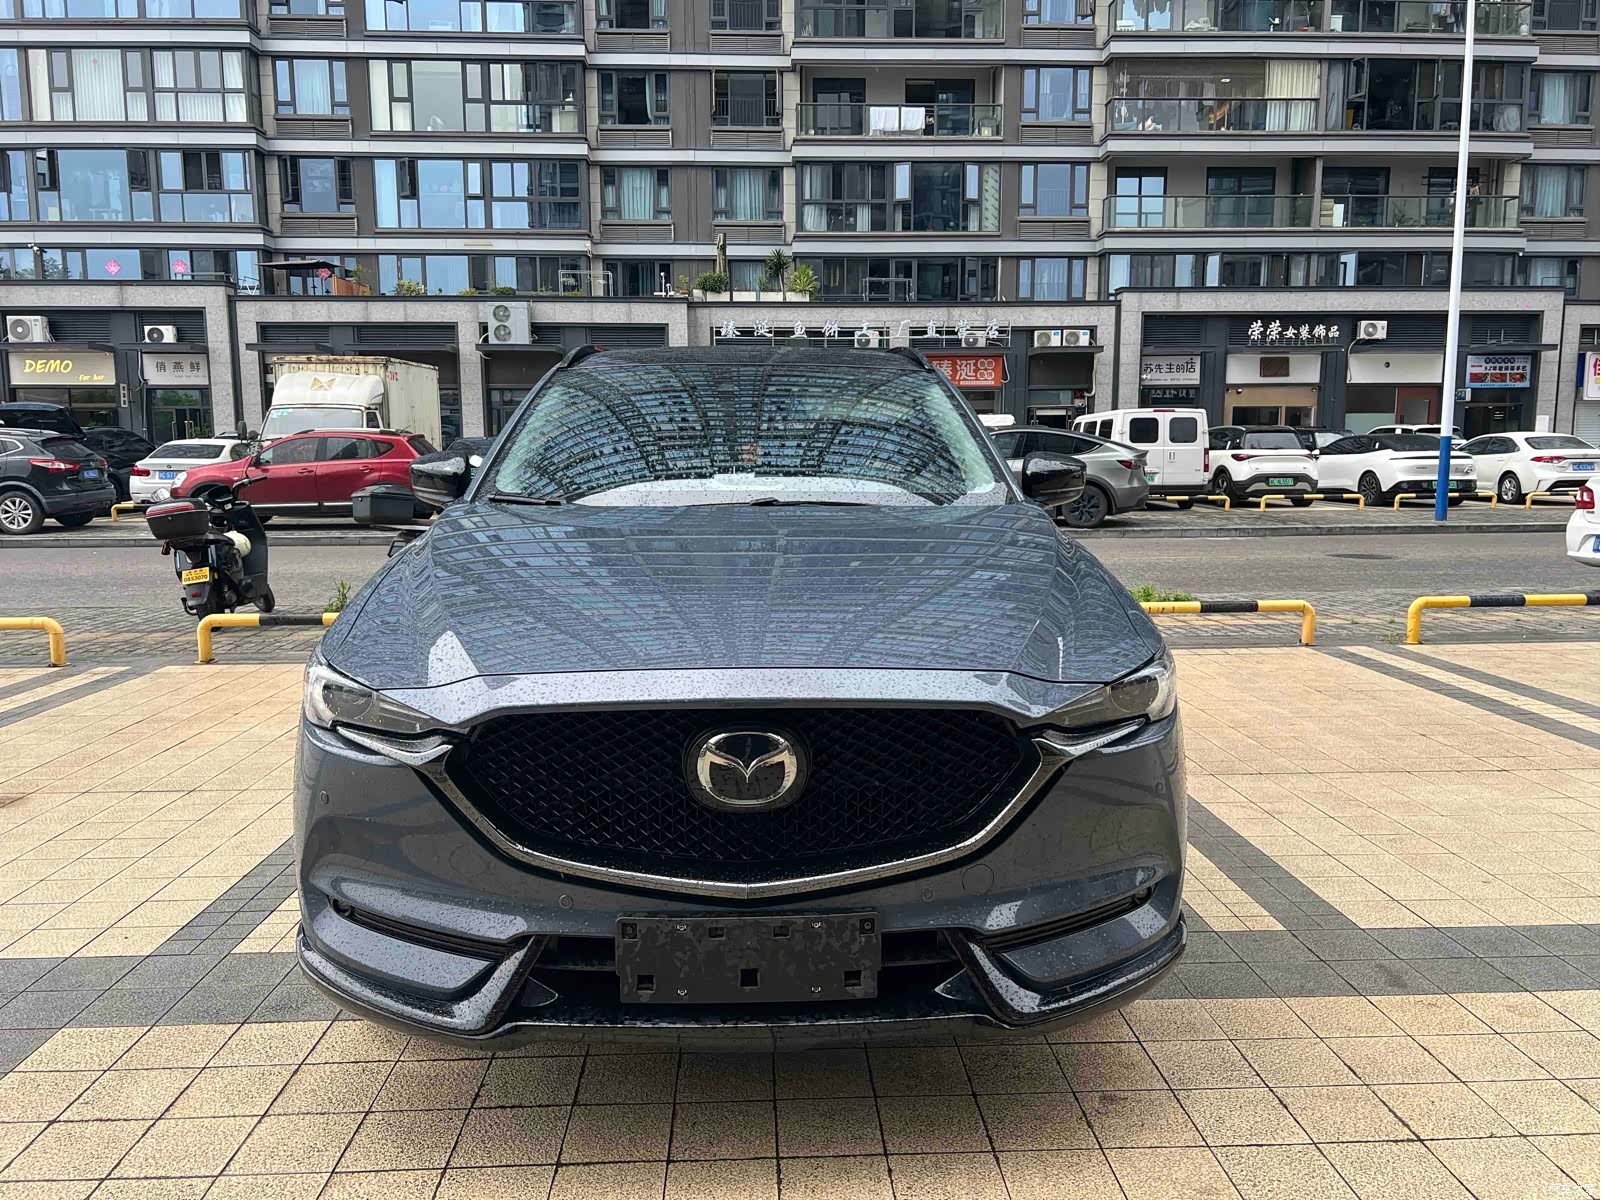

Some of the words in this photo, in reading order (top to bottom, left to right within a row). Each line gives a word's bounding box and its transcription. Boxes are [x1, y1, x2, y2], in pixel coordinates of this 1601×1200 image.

[1248, 320, 1339, 340] 荣荣女装饰品
[24, 360, 72, 373] DEMO
[156, 361, 201, 372] 俏燕鲜
[1144, 358, 1196, 373] 苏先生的店
